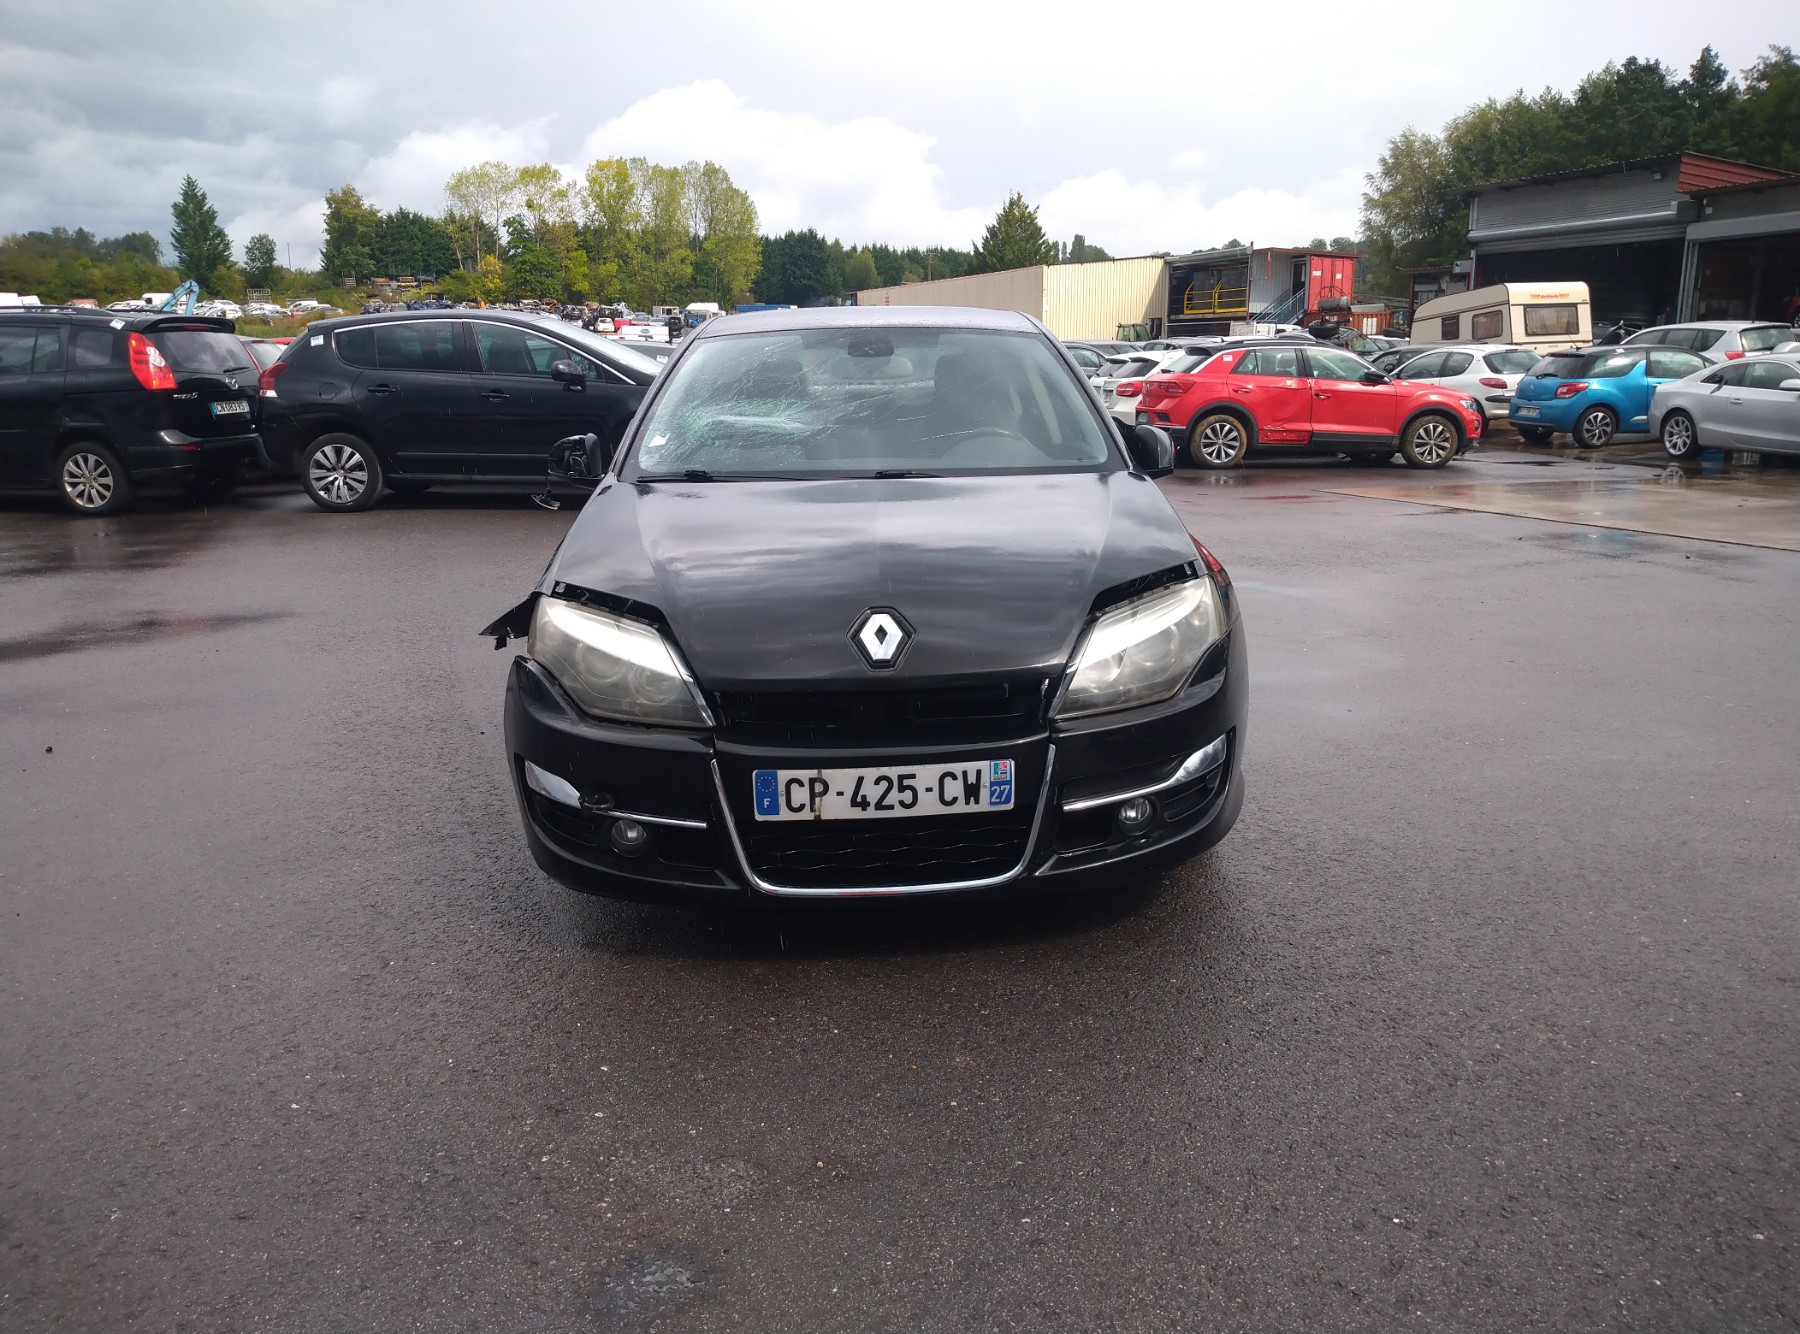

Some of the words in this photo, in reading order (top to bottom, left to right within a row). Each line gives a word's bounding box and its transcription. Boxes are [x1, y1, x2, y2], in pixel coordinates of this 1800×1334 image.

[763, 798, 771, 809] F
[784, 768, 983, 813] CP-425-CW
[991, 784, 1010, 803] 27
